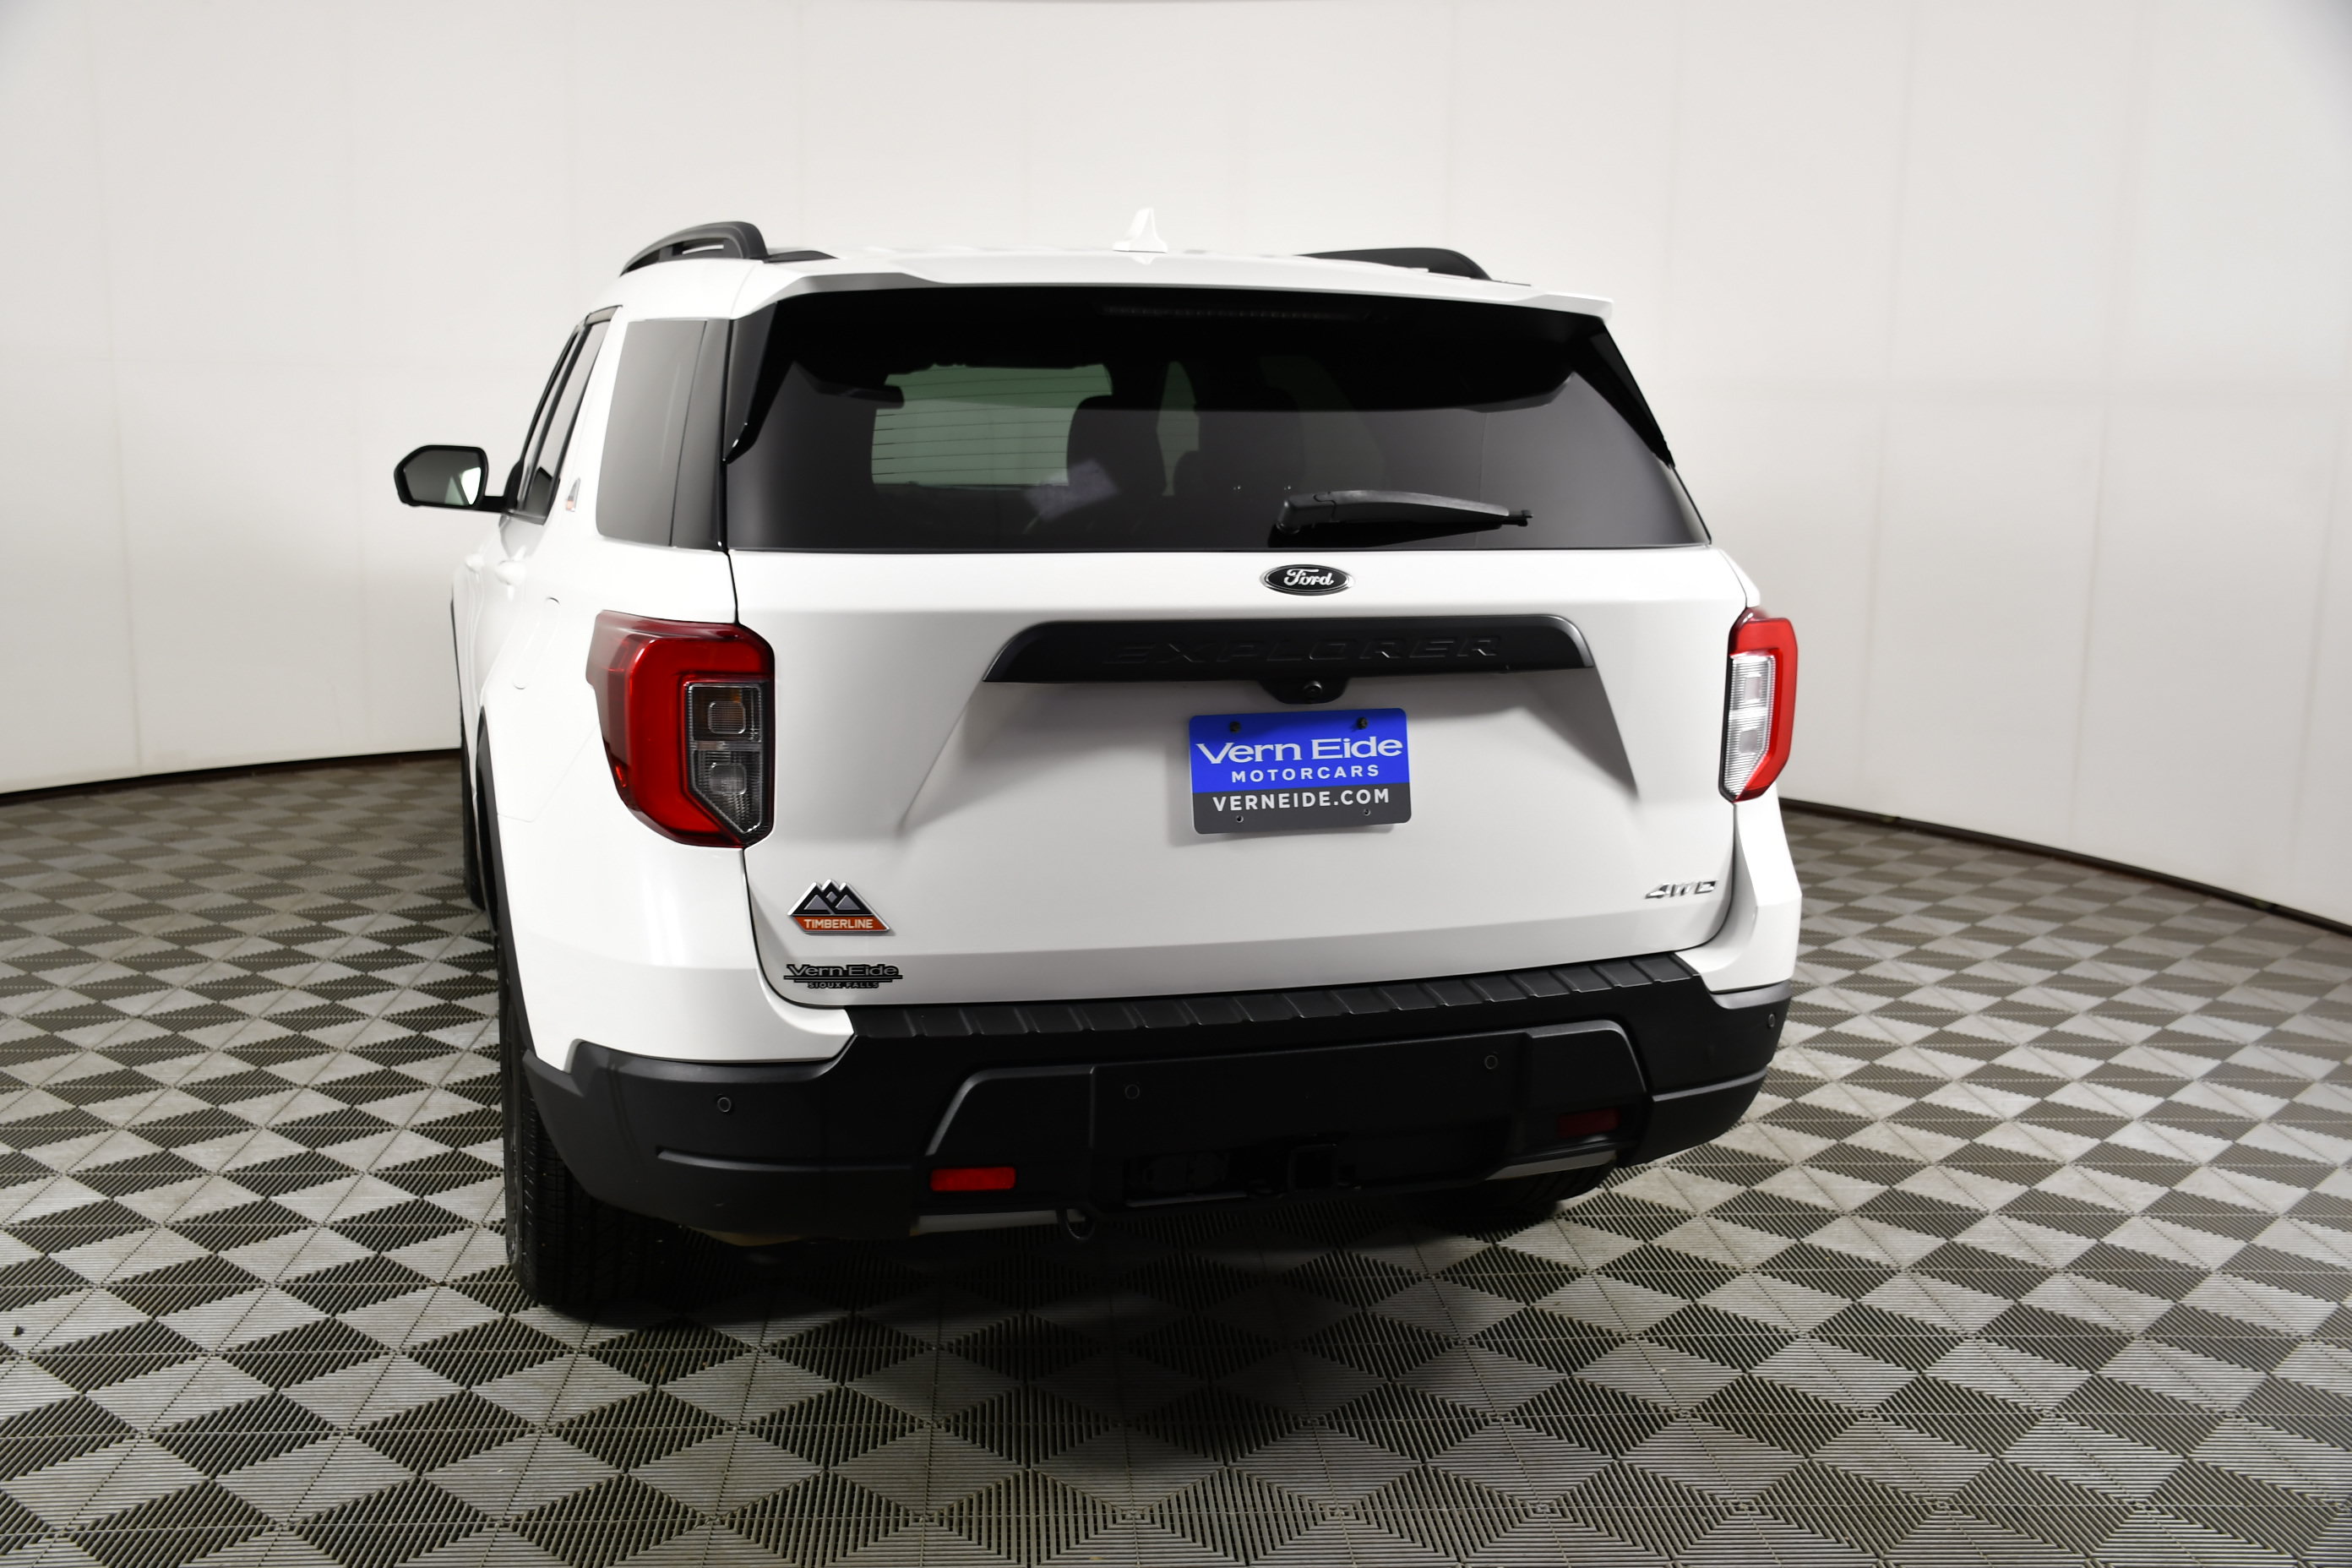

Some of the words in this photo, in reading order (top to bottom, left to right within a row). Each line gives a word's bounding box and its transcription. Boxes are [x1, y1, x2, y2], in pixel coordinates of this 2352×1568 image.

[1284, 569, 1334, 585] Ford
[1102, 636, 1501, 665] EXPLORER
[1196, 742, 1302, 765] Vern
[1311, 736, 1403, 760] Eide
[1231, 764, 1380, 783] MOTORCARS
[1212, 788, 1390, 812] VERNEIDE.COM
[1644, 880, 1717, 900] 4WD
[803, 918, 874, 928] TIMBERLINE
[787, 964, 844, 977] Vern
[847, 964, 900, 977] Eide
